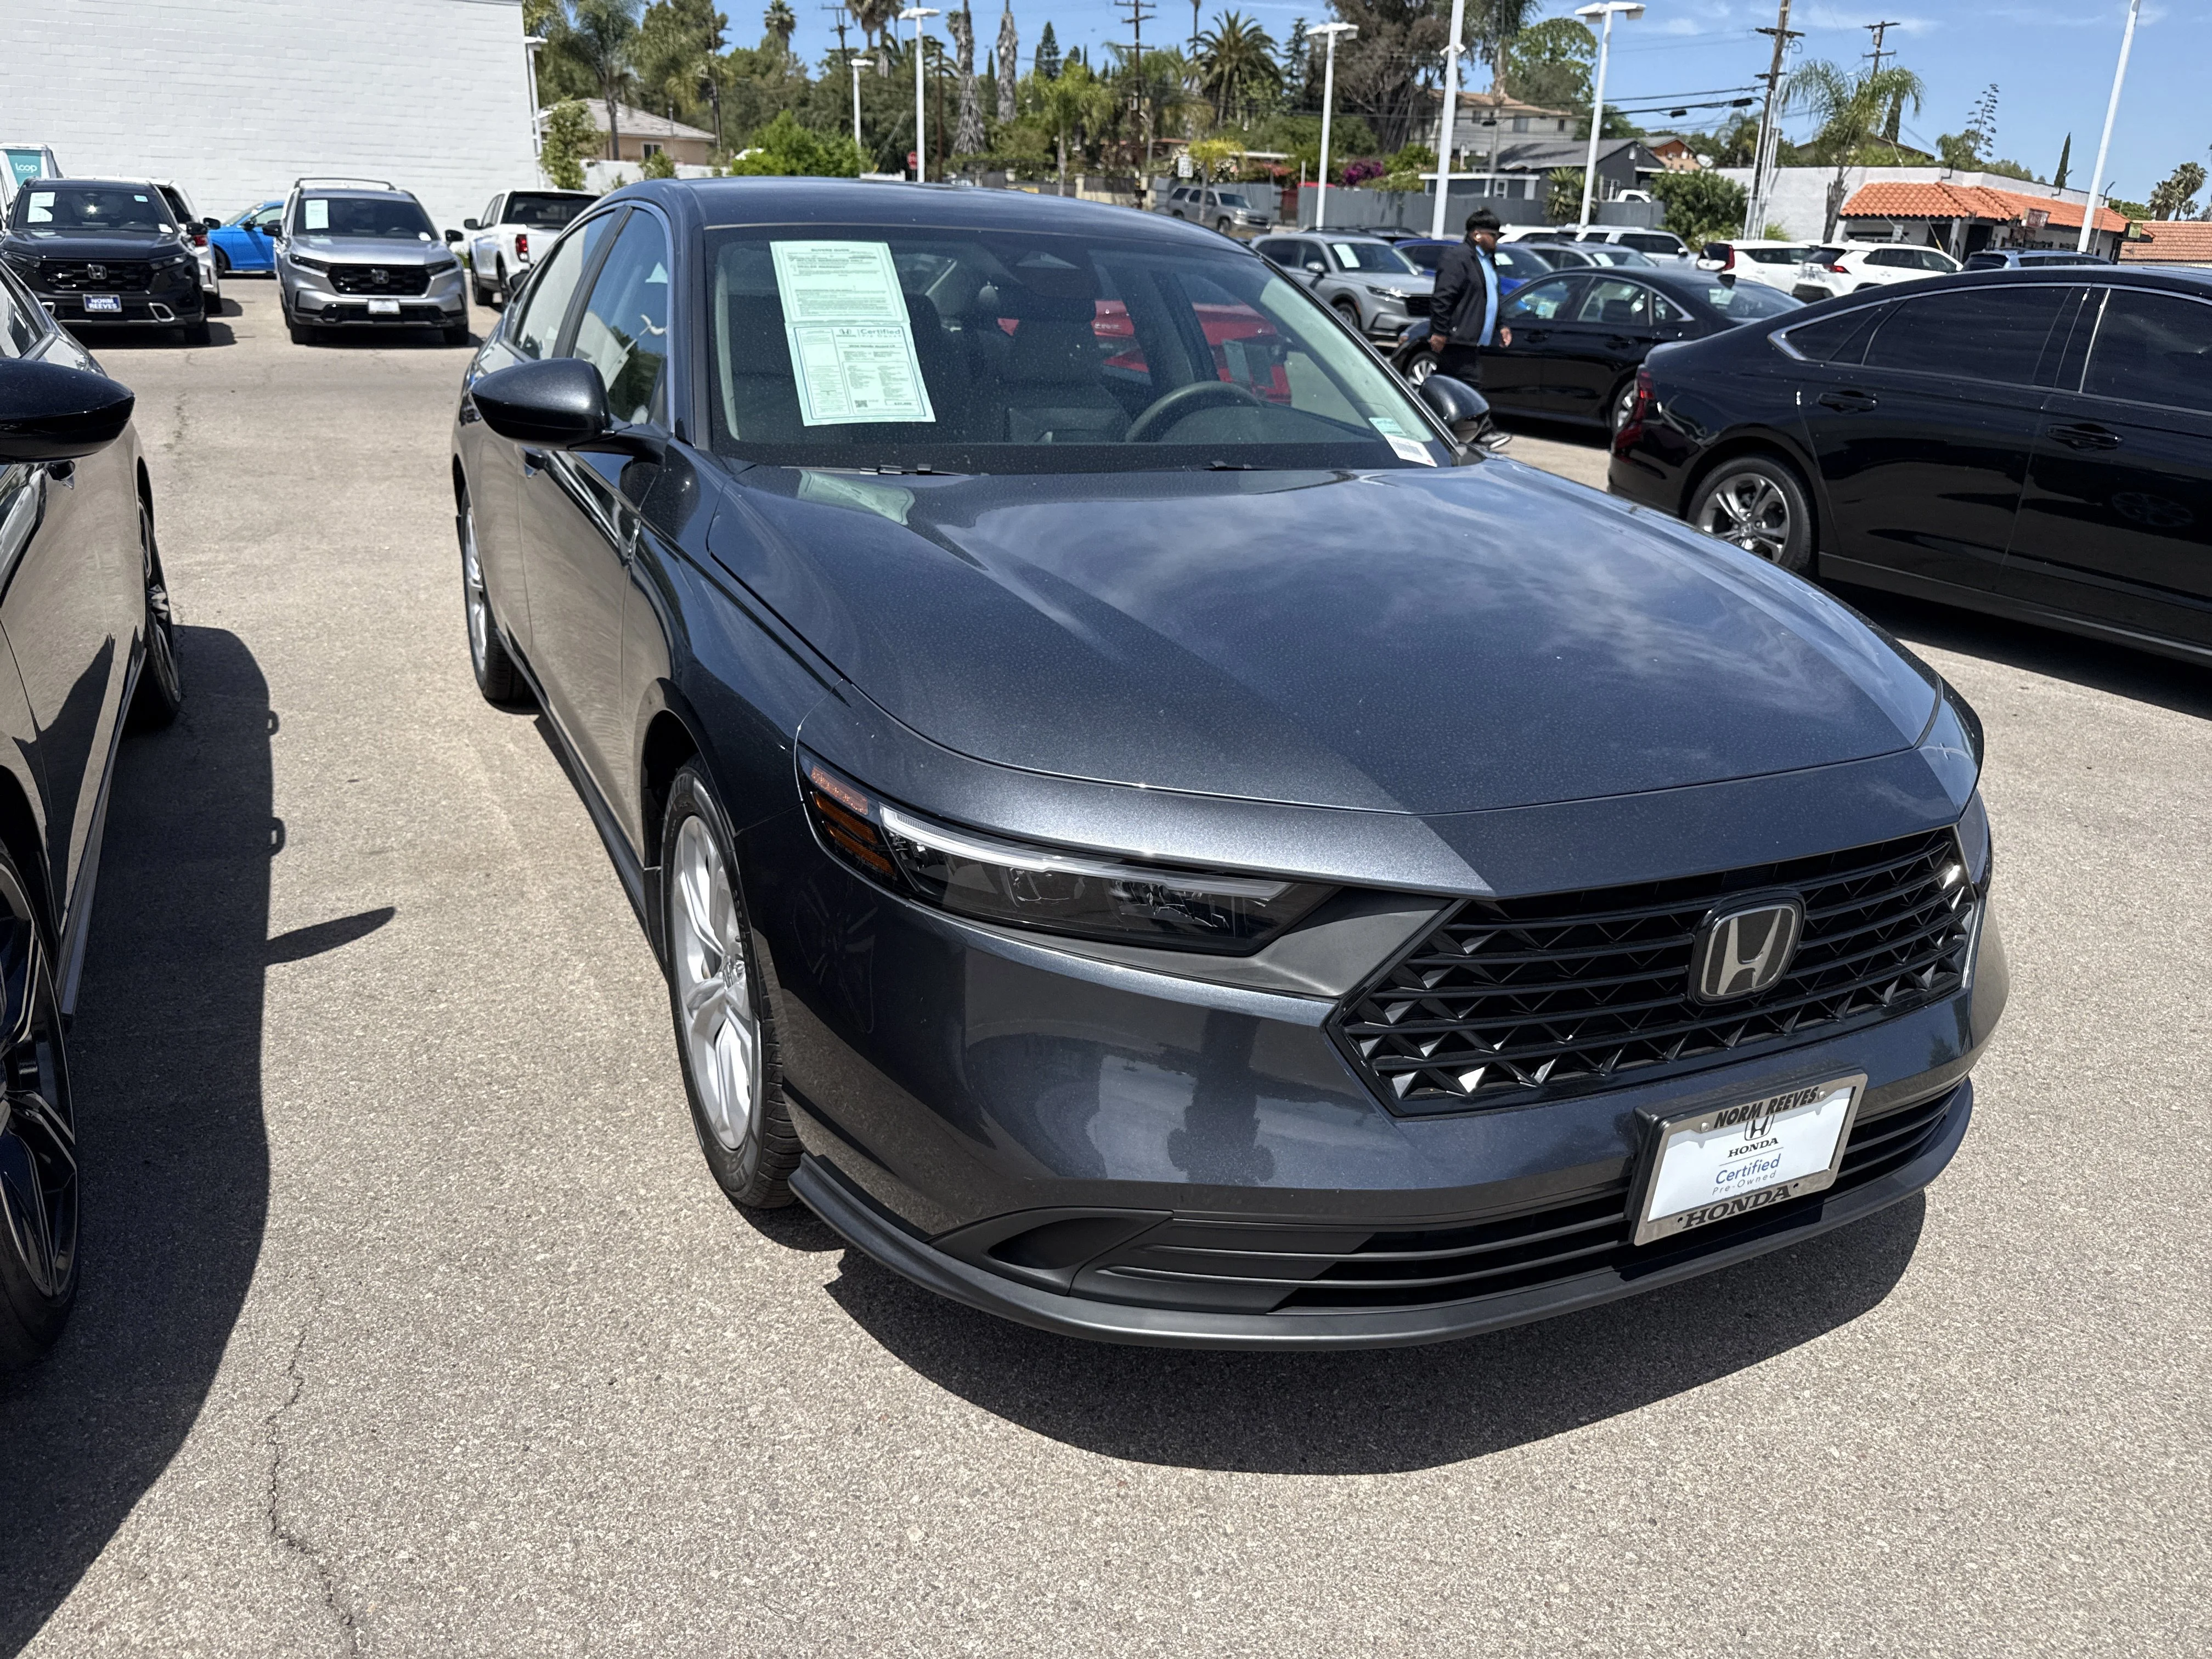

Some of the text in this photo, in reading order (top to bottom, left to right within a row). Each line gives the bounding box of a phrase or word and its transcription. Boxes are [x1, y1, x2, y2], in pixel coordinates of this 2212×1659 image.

[1713, 1086, 1819, 1128] NORM REEVES
[1728, 1137, 1779, 1158] HONDA
[1712, 1170, 1776, 1195] Pre-Owned
[1716, 1153, 1781, 1184] Certified
[1682, 1185, 1791, 1229] HONDA
